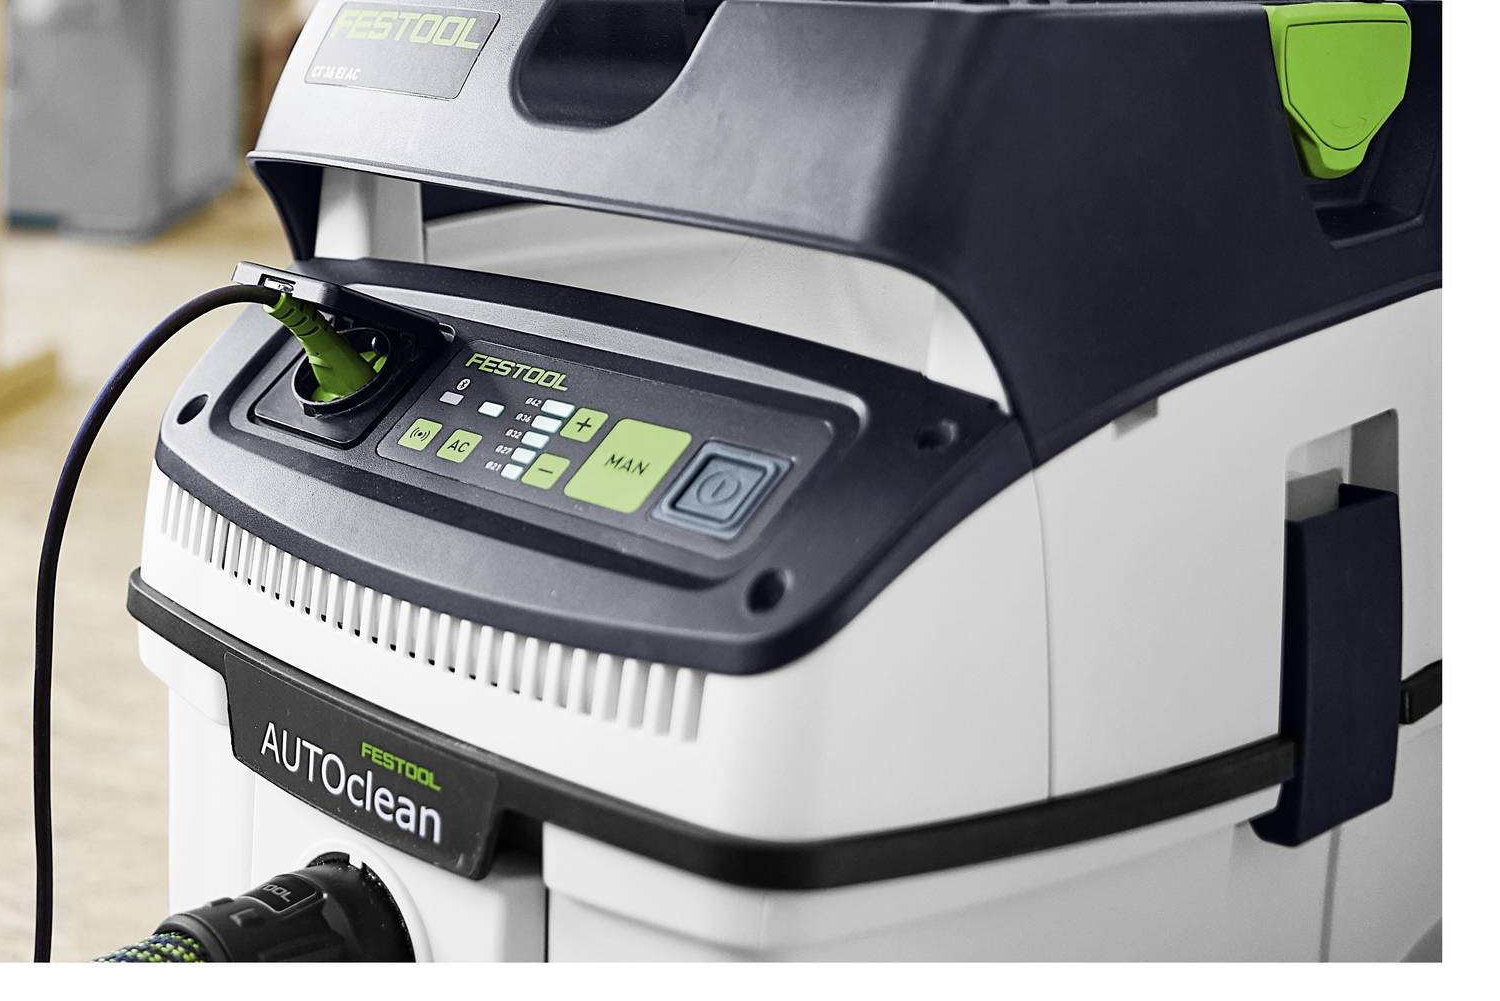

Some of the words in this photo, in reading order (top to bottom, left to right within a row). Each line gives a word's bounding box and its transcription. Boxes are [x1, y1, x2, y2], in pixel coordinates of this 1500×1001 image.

[328, 9, 480, 50] FESTOOL
[465, 352, 568, 392] FESTOOL
[447, 438, 471, 453] AC
[605, 453, 651, 476] MAN
[260, 721, 442, 845] AUTOclean
[361, 741, 442, 792] FESTOOL
